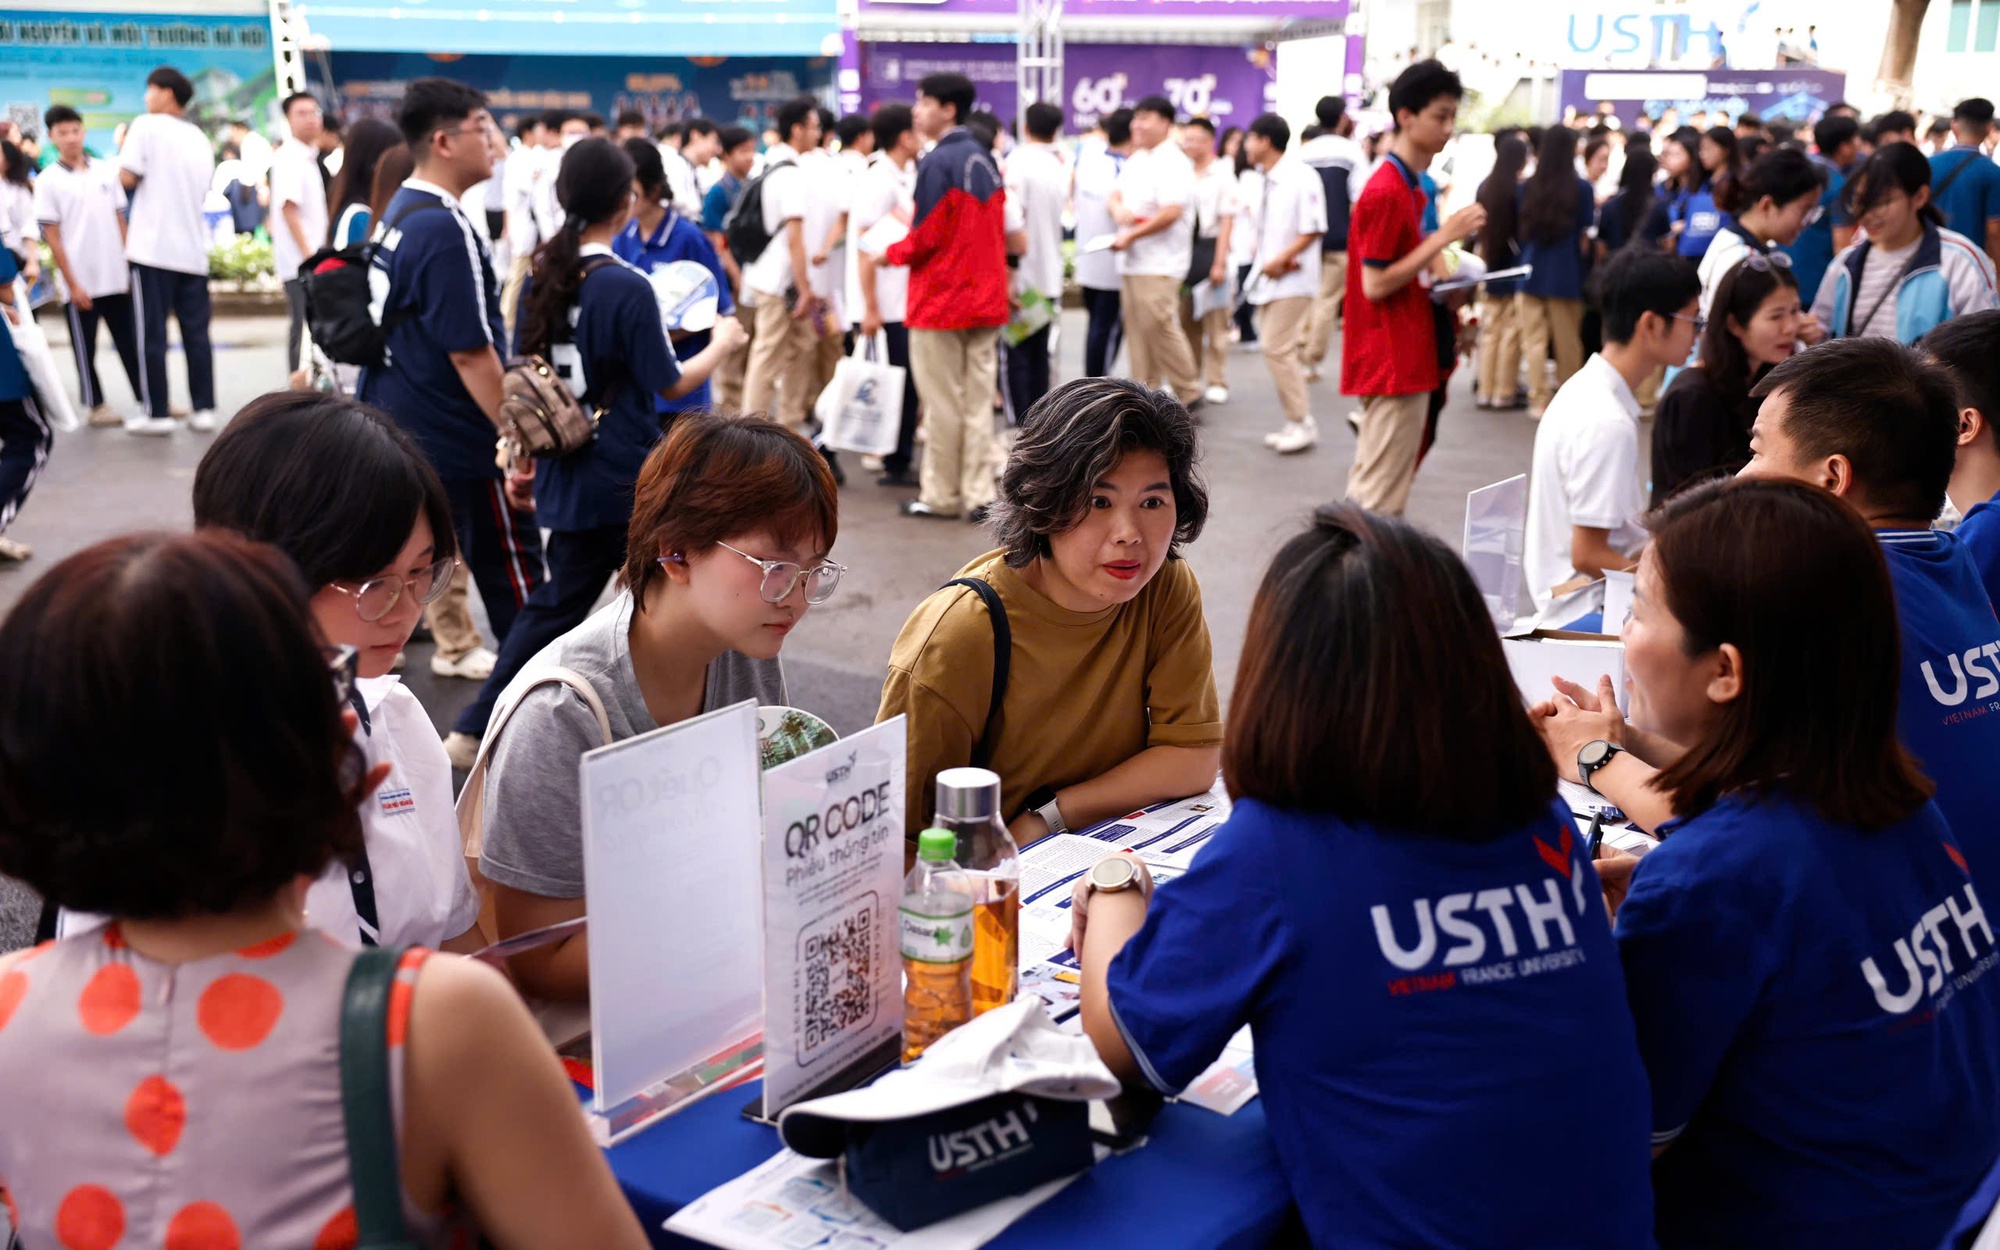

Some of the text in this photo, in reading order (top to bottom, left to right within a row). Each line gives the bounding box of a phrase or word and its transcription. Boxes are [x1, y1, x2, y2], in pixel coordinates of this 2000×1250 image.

[1567, 14, 1720, 54] USTH
[1920, 640, 2000, 706] UST
[1943, 705, 1988, 725] VIETNAM
[784, 812, 820, 859] QR
[824, 780, 890, 839] CODE
[1370, 878, 1576, 971] USTH
[1860, 882, 1995, 1014] USTH
[1387, 948, 1587, 996] VIETNAM FRANCE UNIVERSITY
[928, 1109, 1030, 1172] USTH
